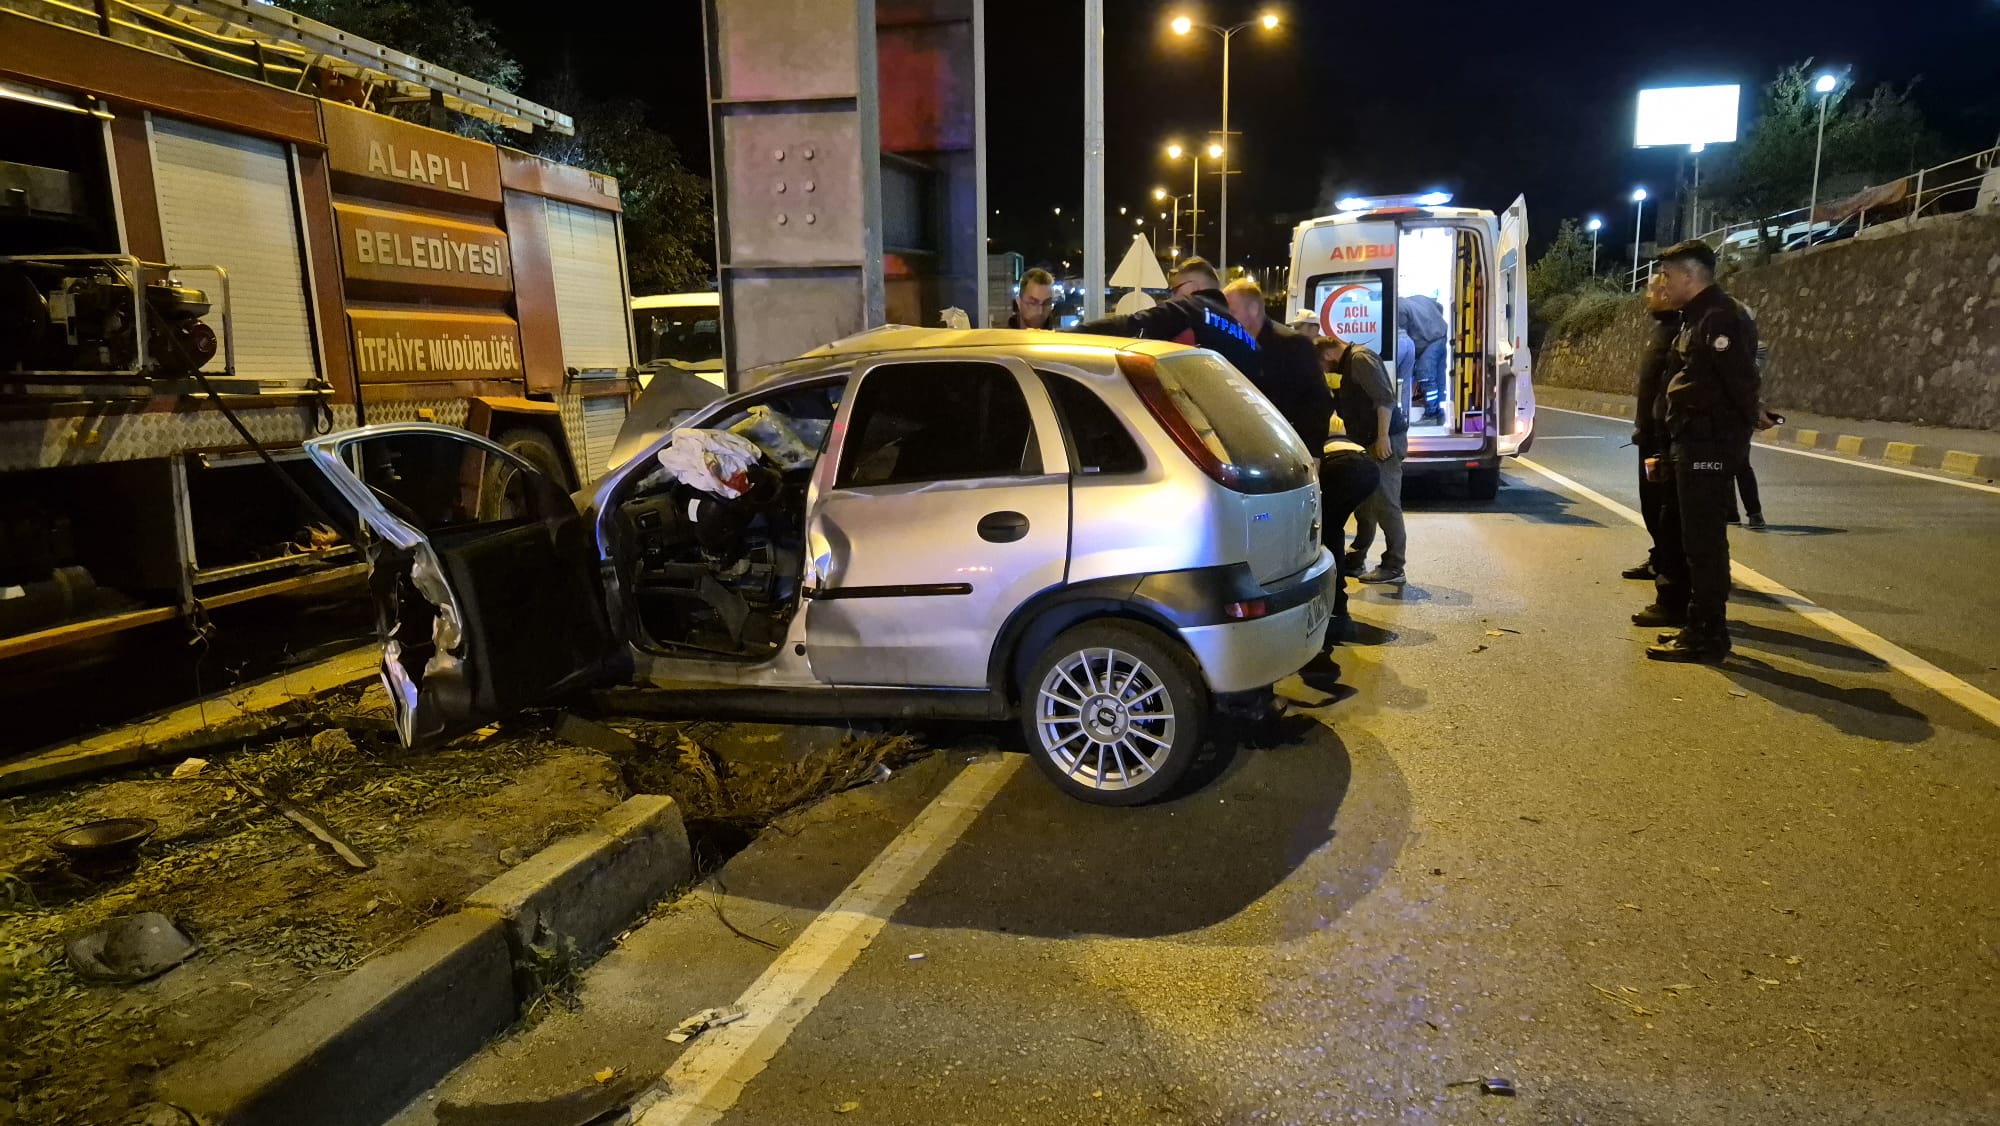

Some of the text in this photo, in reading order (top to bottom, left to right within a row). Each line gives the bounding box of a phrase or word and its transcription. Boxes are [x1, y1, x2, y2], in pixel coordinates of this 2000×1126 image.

[368, 140, 470, 192] ALAPLI
[355, 228, 503, 276] BELEDİYESİ
[1330, 243, 1396, 261] AMBU
[1344, 304, 1369, 318] ACİL
[1336, 319, 1377, 334] SAĞLIK
[357, 330, 427, 372] İTFAİYE
